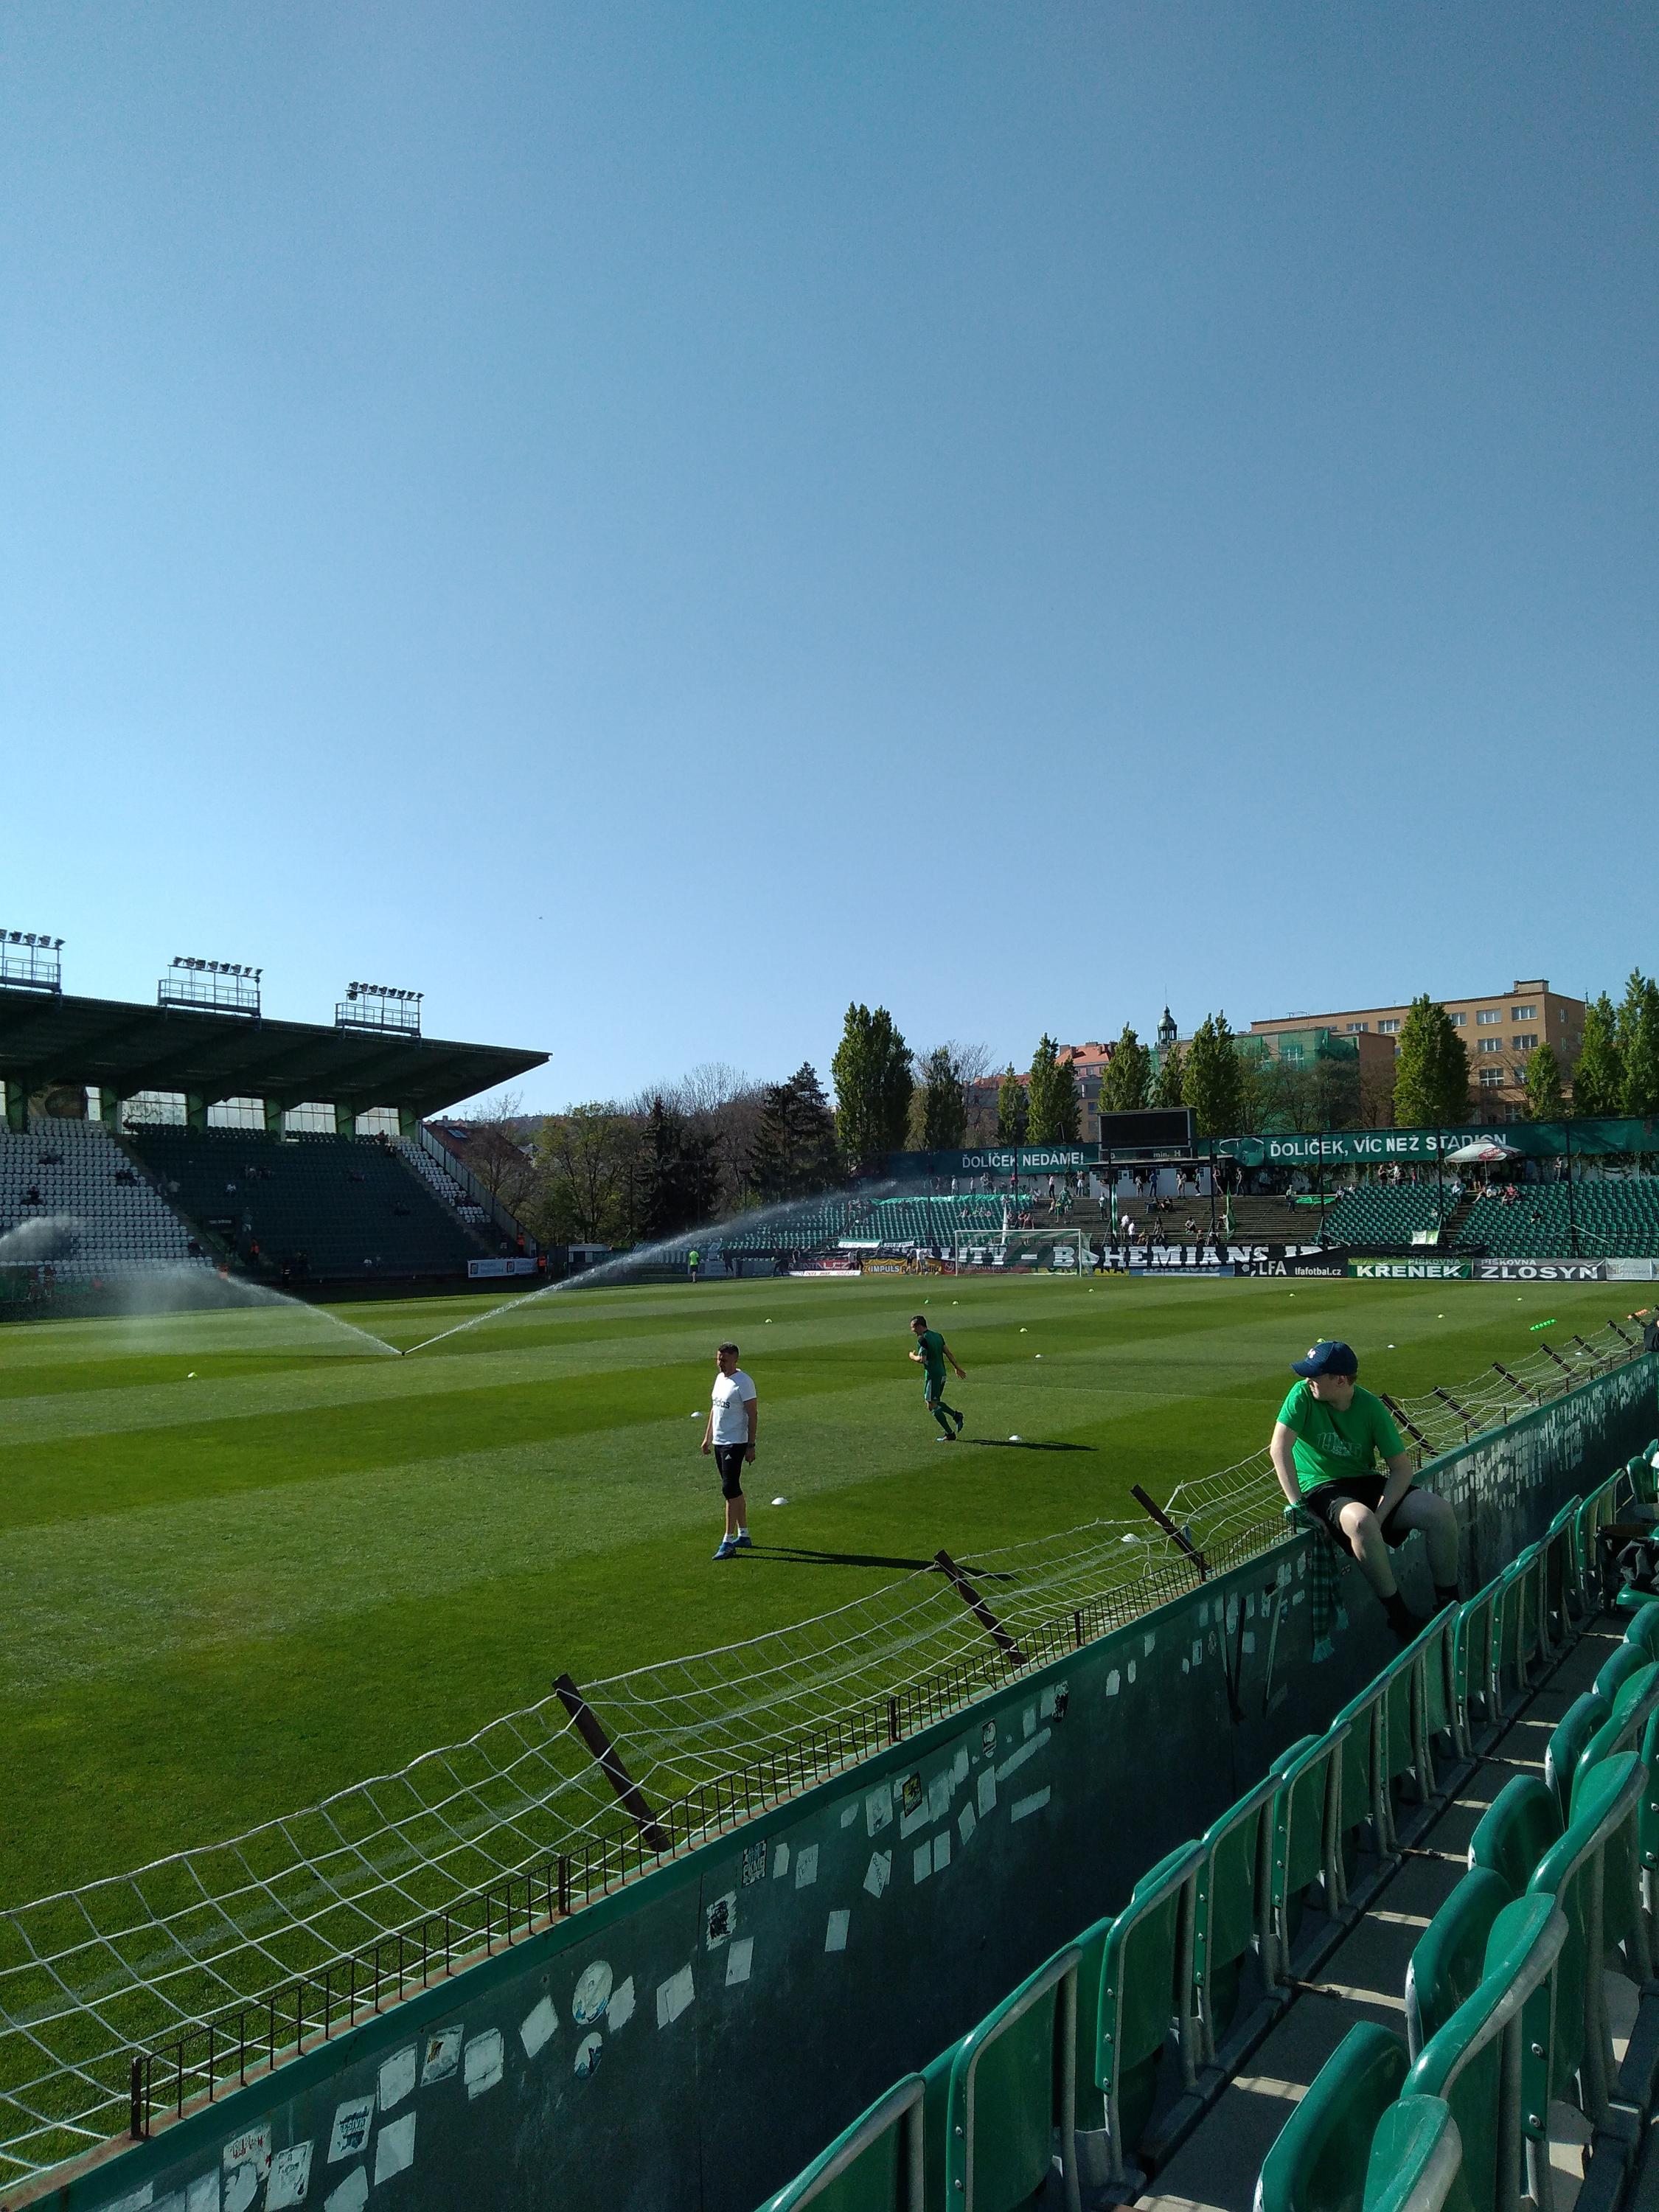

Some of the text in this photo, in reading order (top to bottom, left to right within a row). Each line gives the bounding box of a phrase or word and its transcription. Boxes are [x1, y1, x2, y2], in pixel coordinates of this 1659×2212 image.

[1353, 1136, 1382, 1154] VÍC
[1385, 1135, 1419, 1152] NEŽ
[1023, 1150, 1085, 1167] NEDÁME!
[870, 1265, 900, 1273] IMPULS
[1259, 1260, 1342, 1276] LFA lfafotbal.cz
[1356, 1262, 1463, 1278] KŘENEK
[1481, 1261, 1602, 1279] ZLOSYŇ
